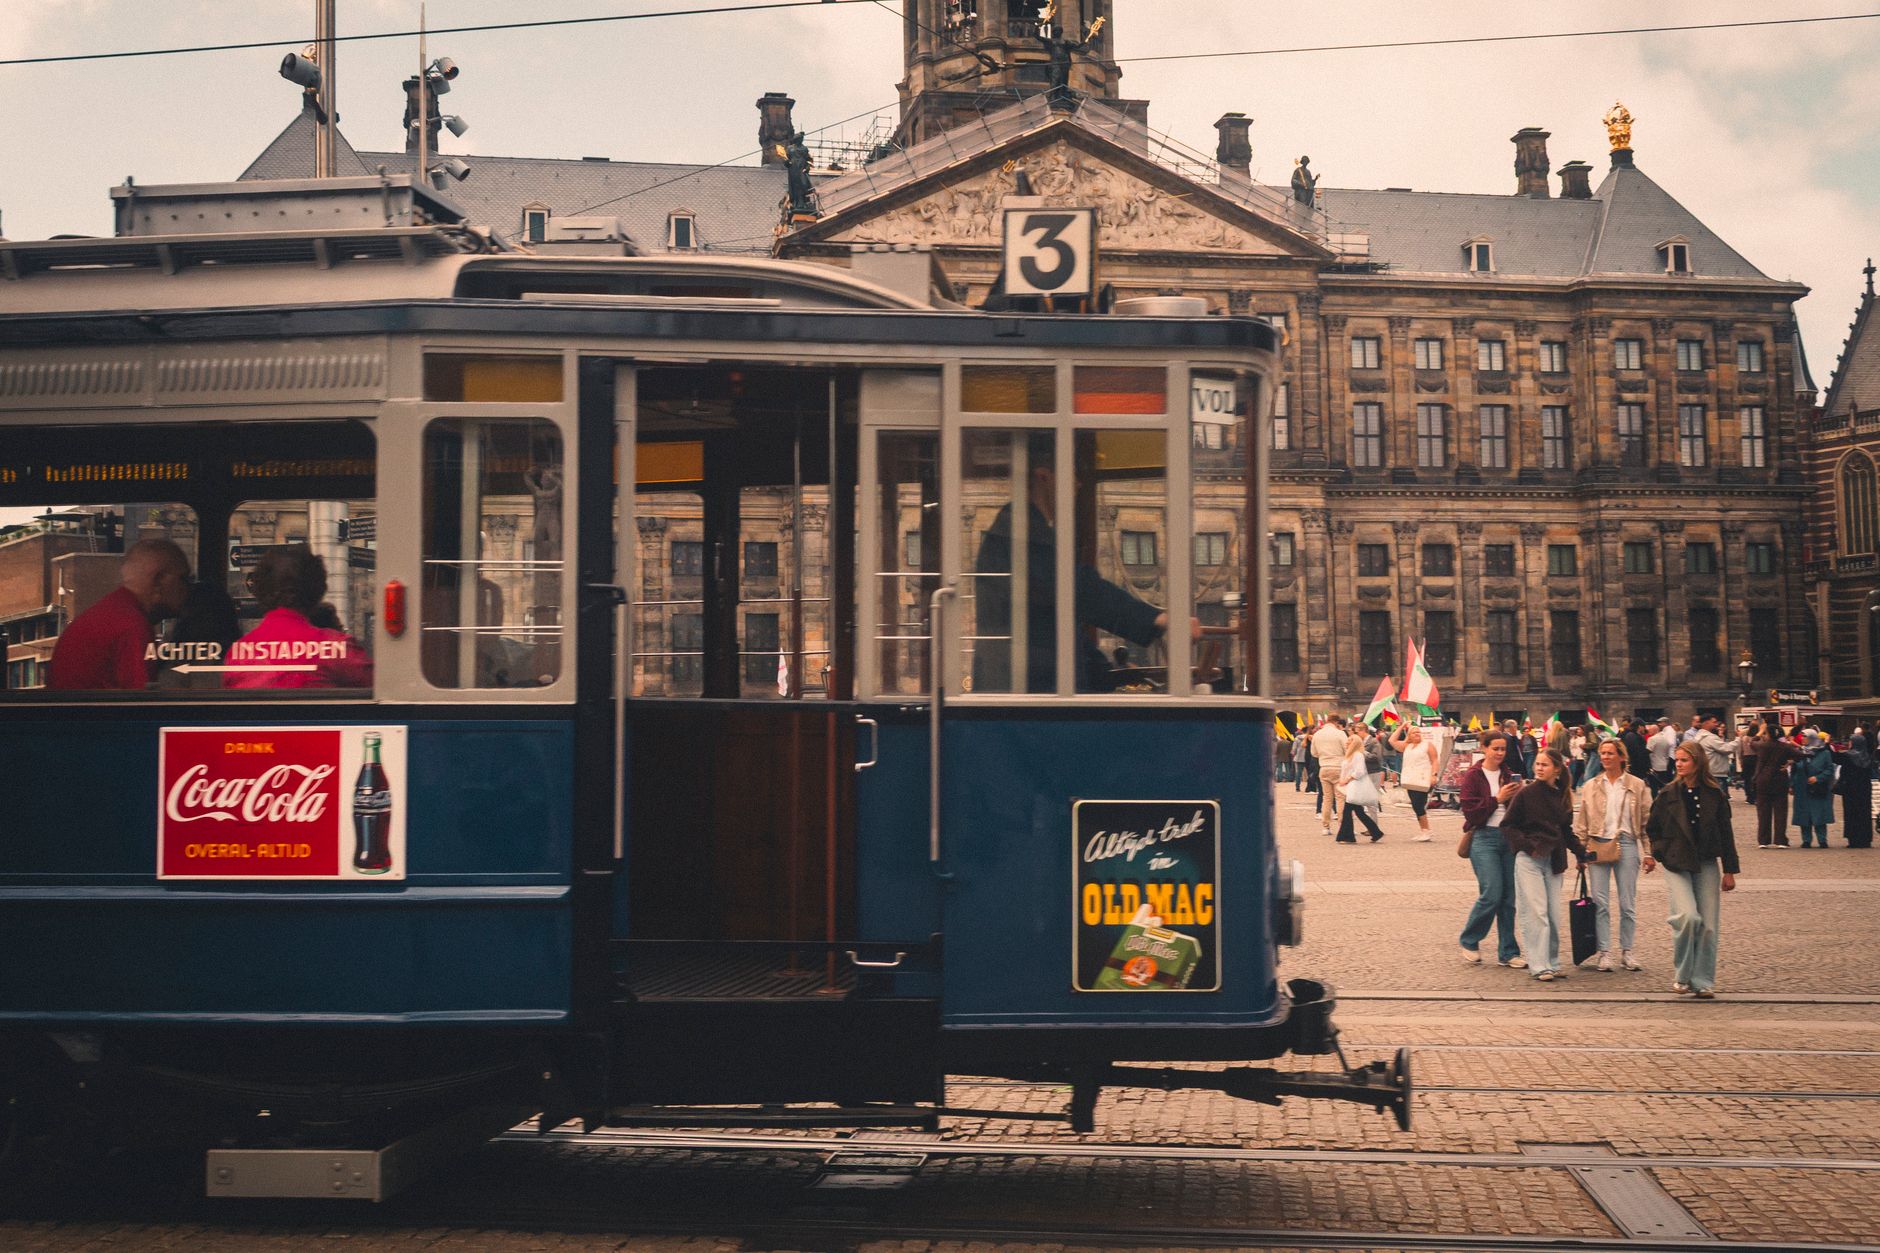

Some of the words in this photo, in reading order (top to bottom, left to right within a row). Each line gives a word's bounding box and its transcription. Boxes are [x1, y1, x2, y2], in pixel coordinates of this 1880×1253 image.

[1019, 213, 1077, 291] 3
[1192, 387, 1235, 415] VOL
[143, 641, 222, 661] ACHTER
[231, 640, 347, 660] INSTAPPEN
[224, 742, 275, 754] DRINK
[166, 763, 337, 823] Coca-Cola
[184, 842, 312, 859] OVERAL-ALTIJD
[1146, 851, 1180, 871] in
[1083, 883, 1140, 926] OLD
[1145, 883, 1214, 926] MAC
